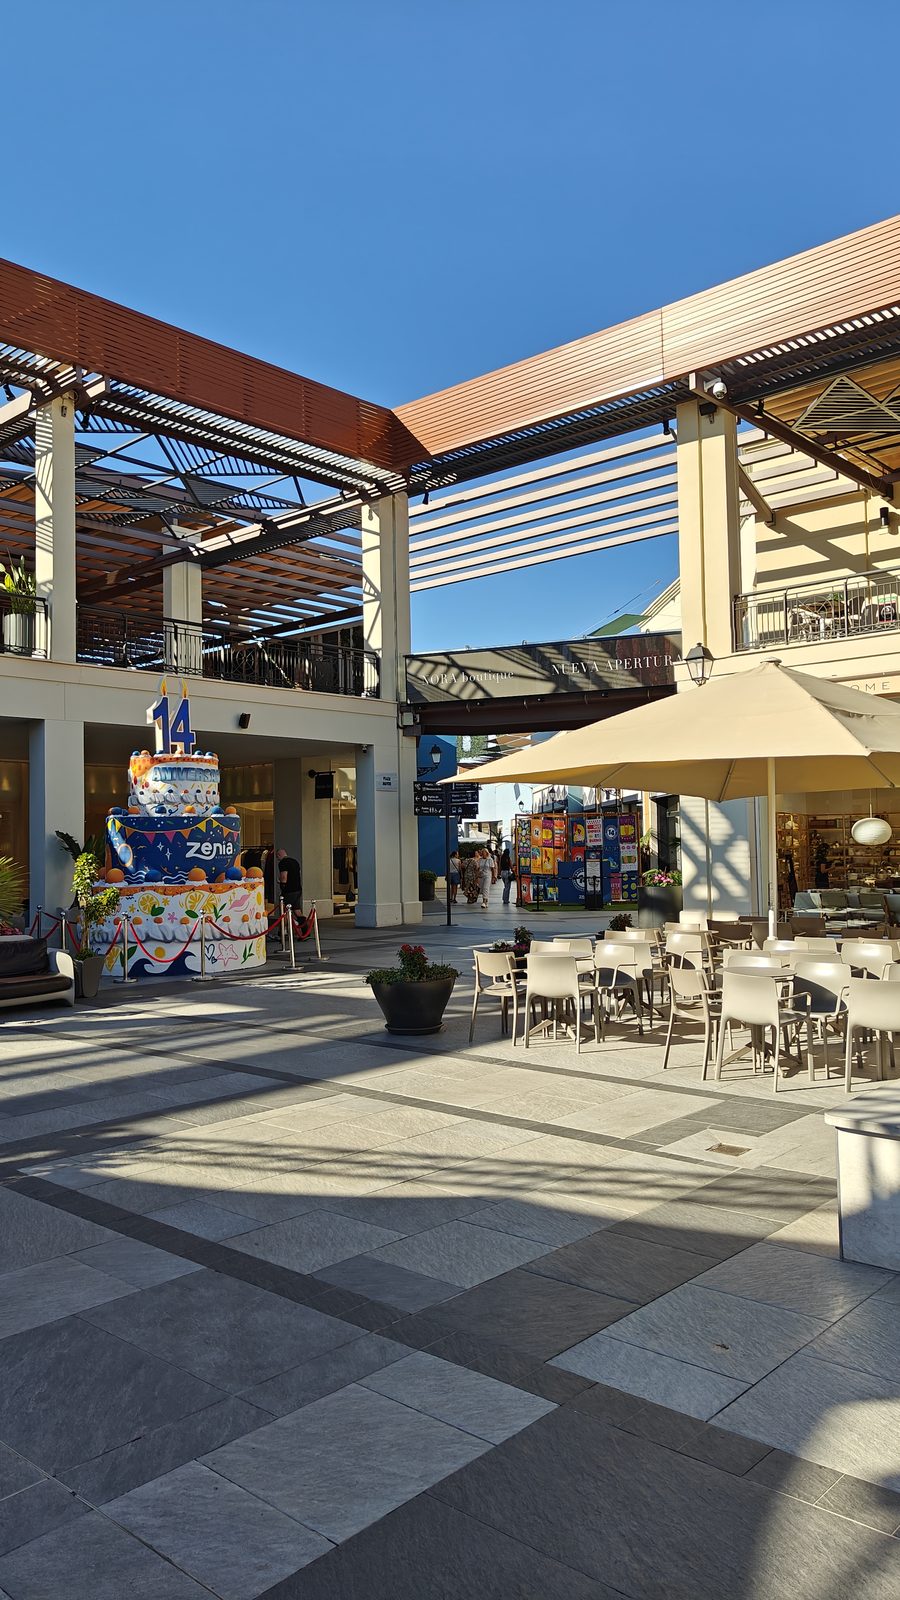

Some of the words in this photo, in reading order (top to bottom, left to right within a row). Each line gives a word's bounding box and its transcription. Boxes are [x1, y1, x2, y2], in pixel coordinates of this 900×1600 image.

[551, 661, 599, 676] NUEVA
[422, 672, 457, 685] NORA
[462, 669, 514, 683] boutique
[152, 695, 197, 755] 14
[608, 827, 615, 836] 14
